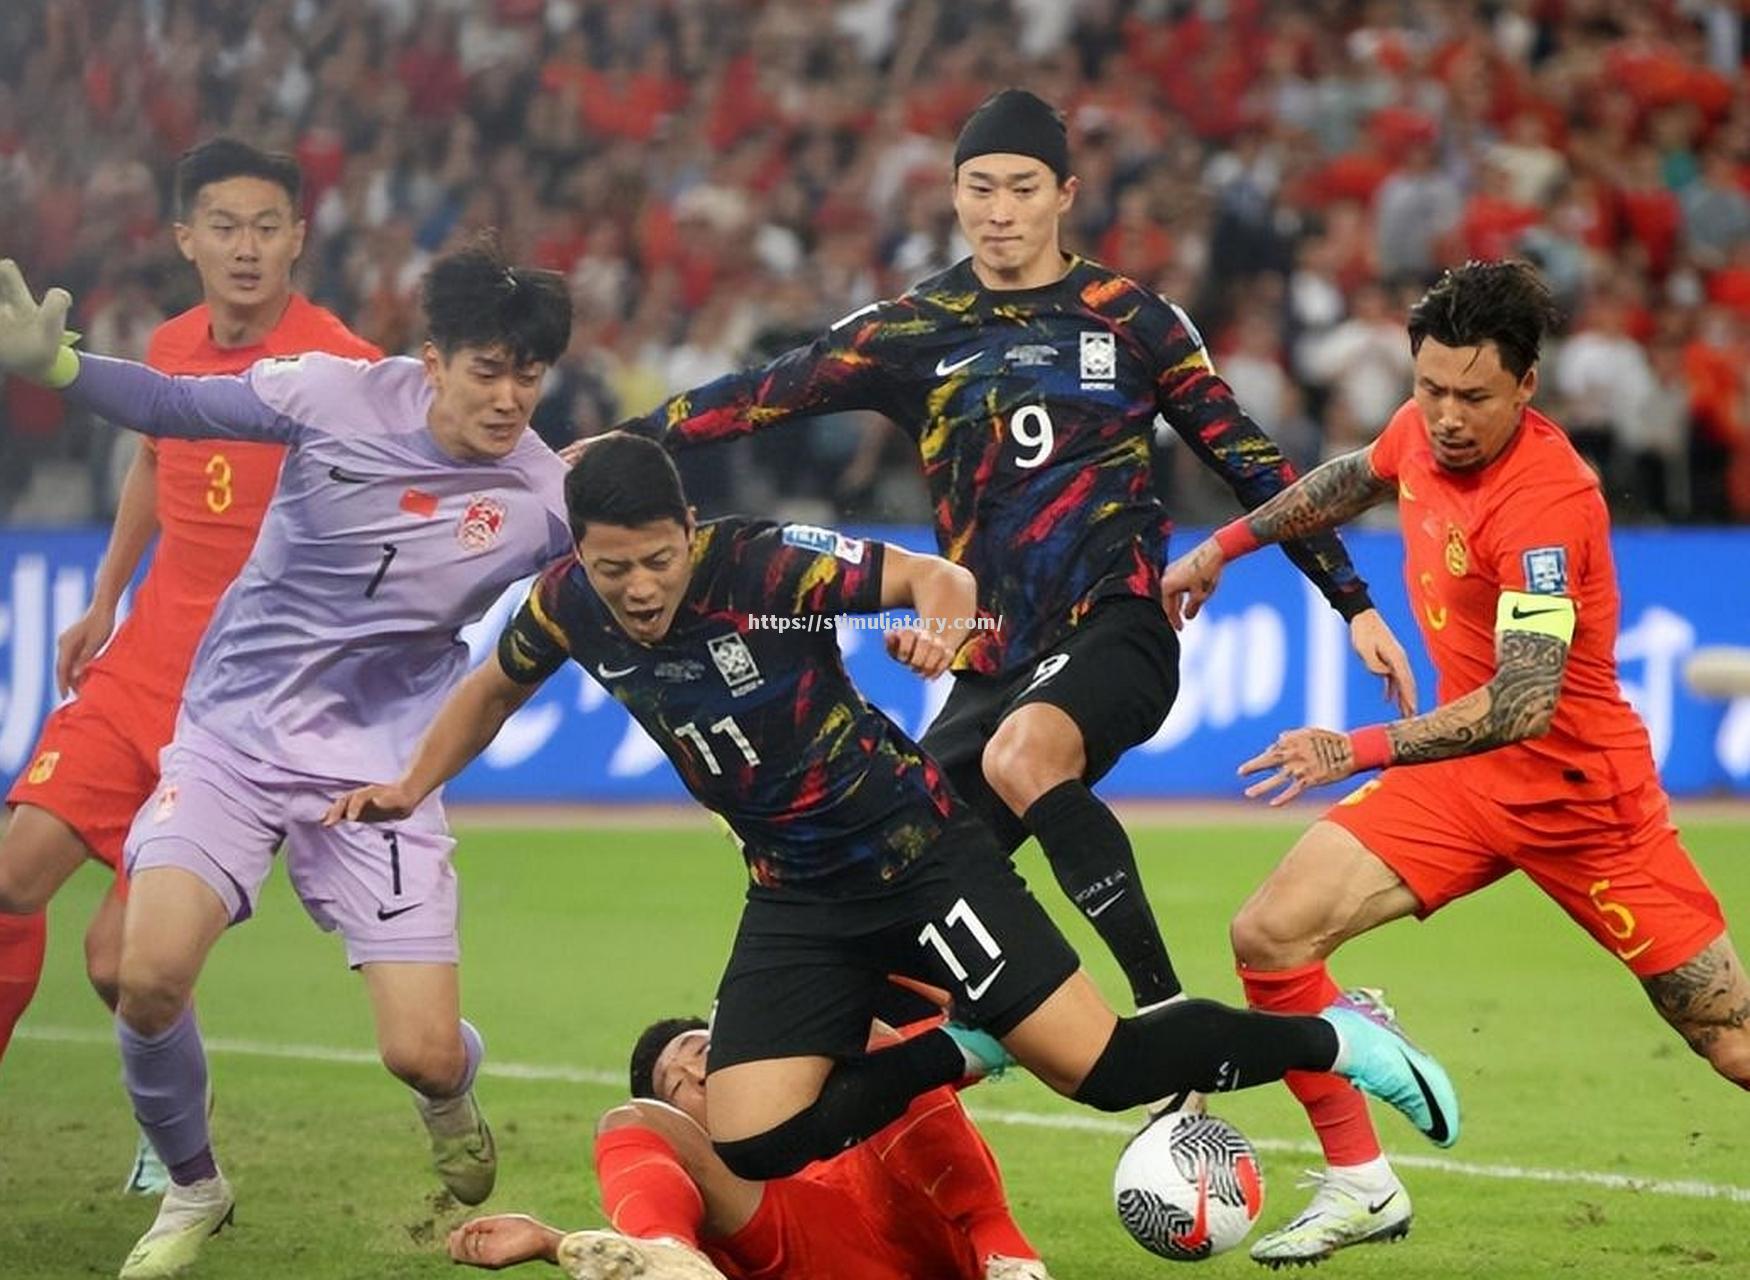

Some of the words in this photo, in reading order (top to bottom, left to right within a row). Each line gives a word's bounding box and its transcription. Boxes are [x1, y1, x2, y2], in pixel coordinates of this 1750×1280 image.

[1010, 404, 1054, 469] 9
[205, 454, 232, 513] 3
[1018, 652, 1071, 700] 9
[674, 715, 761, 775] 11
[383, 829, 402, 896] 1
[1589, 879, 1635, 939] 5
[918, 897, 1003, 982] 11
